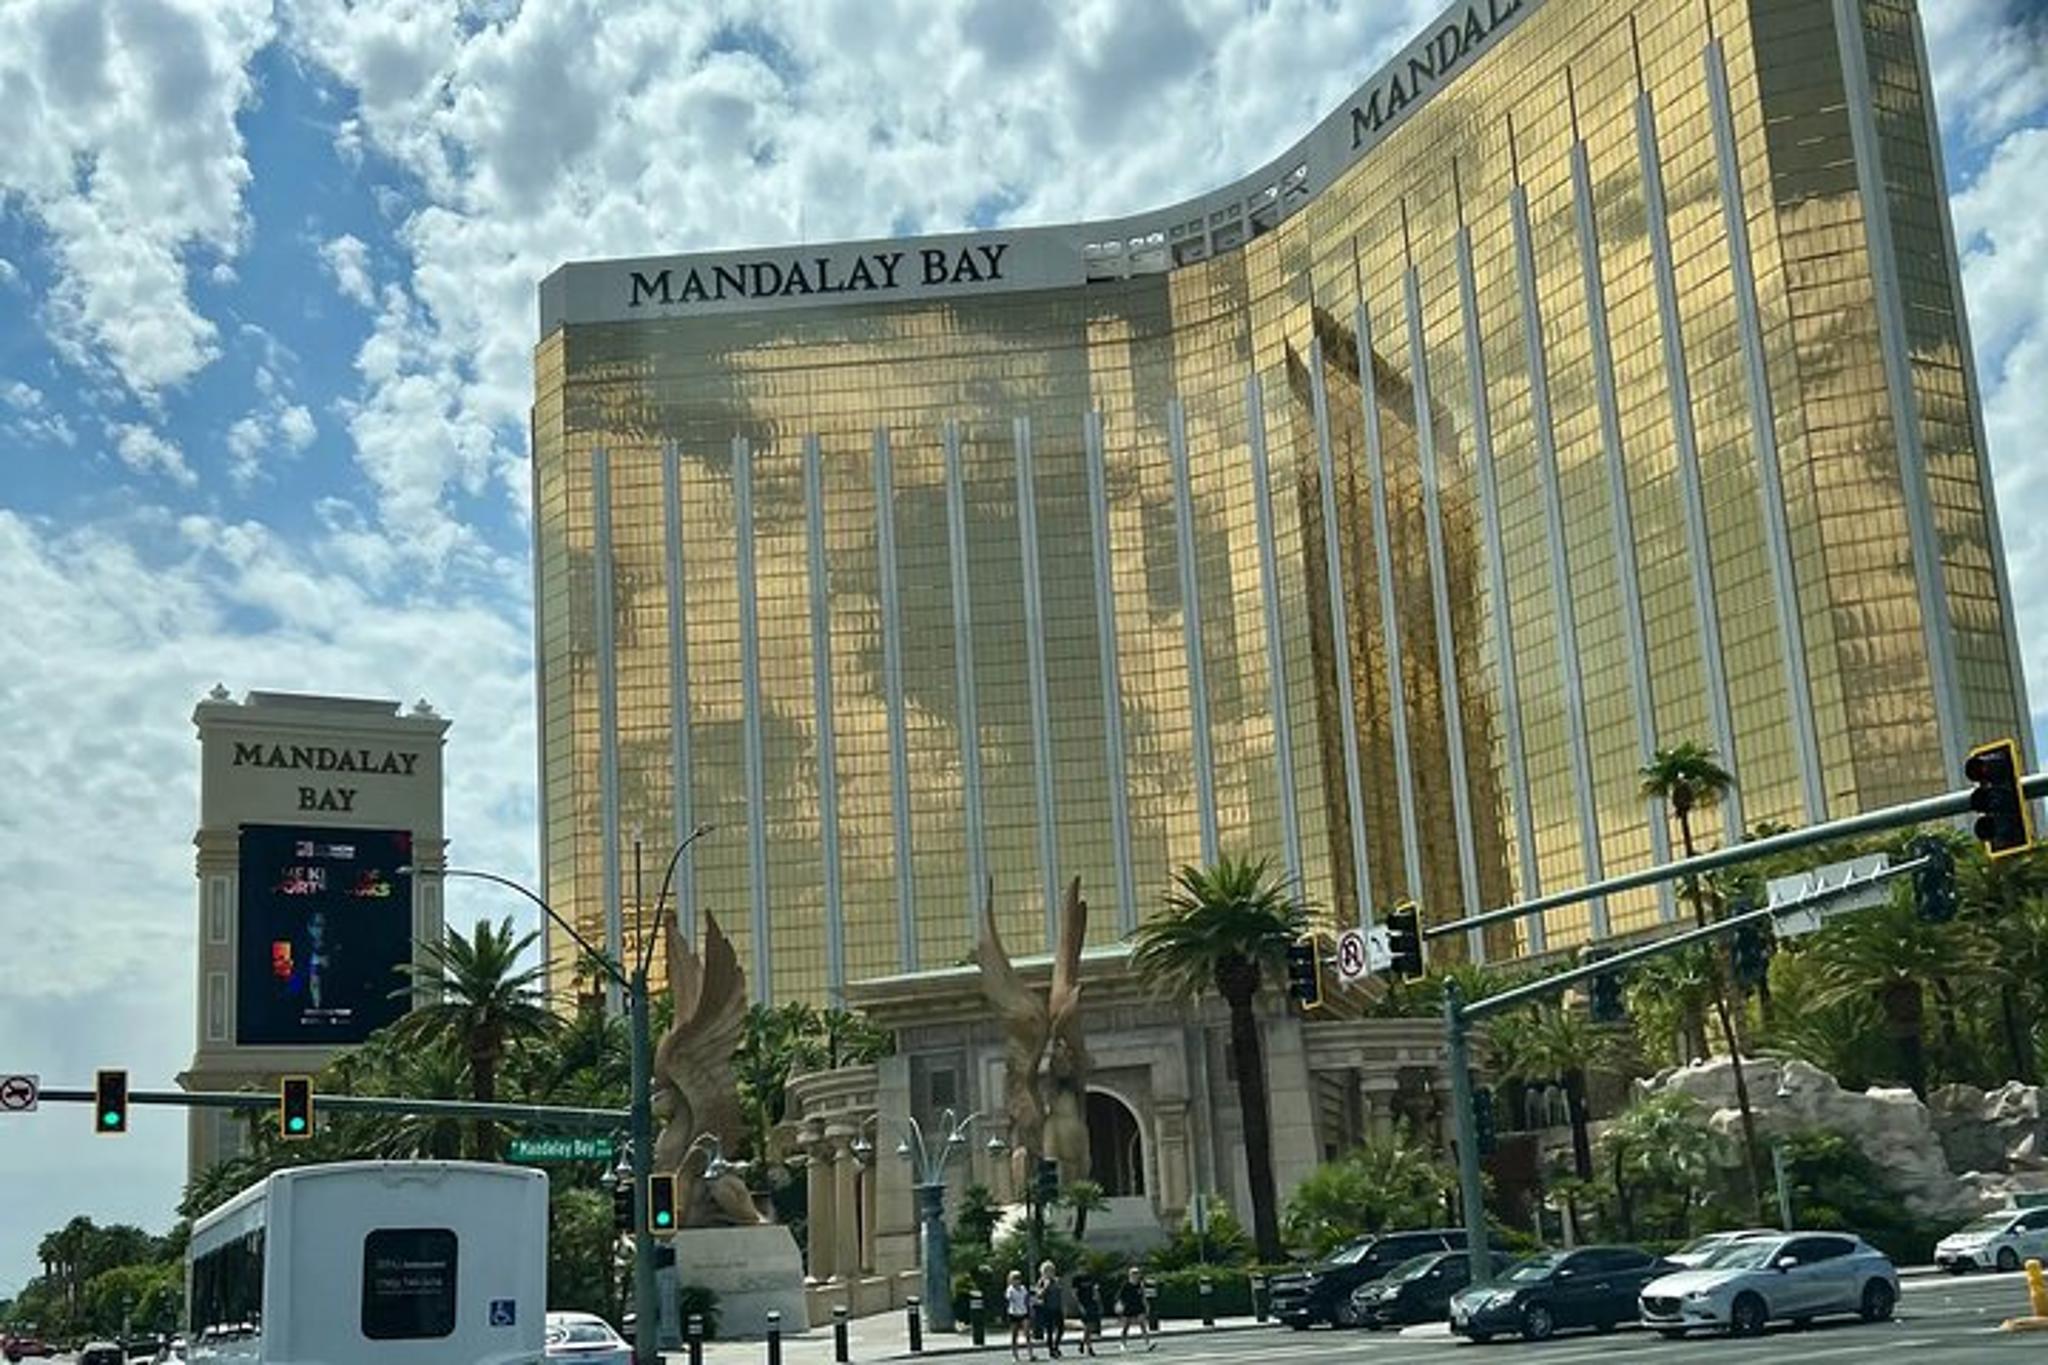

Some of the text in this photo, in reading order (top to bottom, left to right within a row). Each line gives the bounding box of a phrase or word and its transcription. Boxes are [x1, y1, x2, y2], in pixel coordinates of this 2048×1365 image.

[1351, 0, 1522, 149] MANDAL
[629, 243, 1010, 307] MANDALAY BAY
[233, 742, 419, 776] MANDALAY
[298, 787, 358, 811] BAY
[520, 1139, 572, 1159] Mandalay
[574, 1139, 596, 1158] Bay
